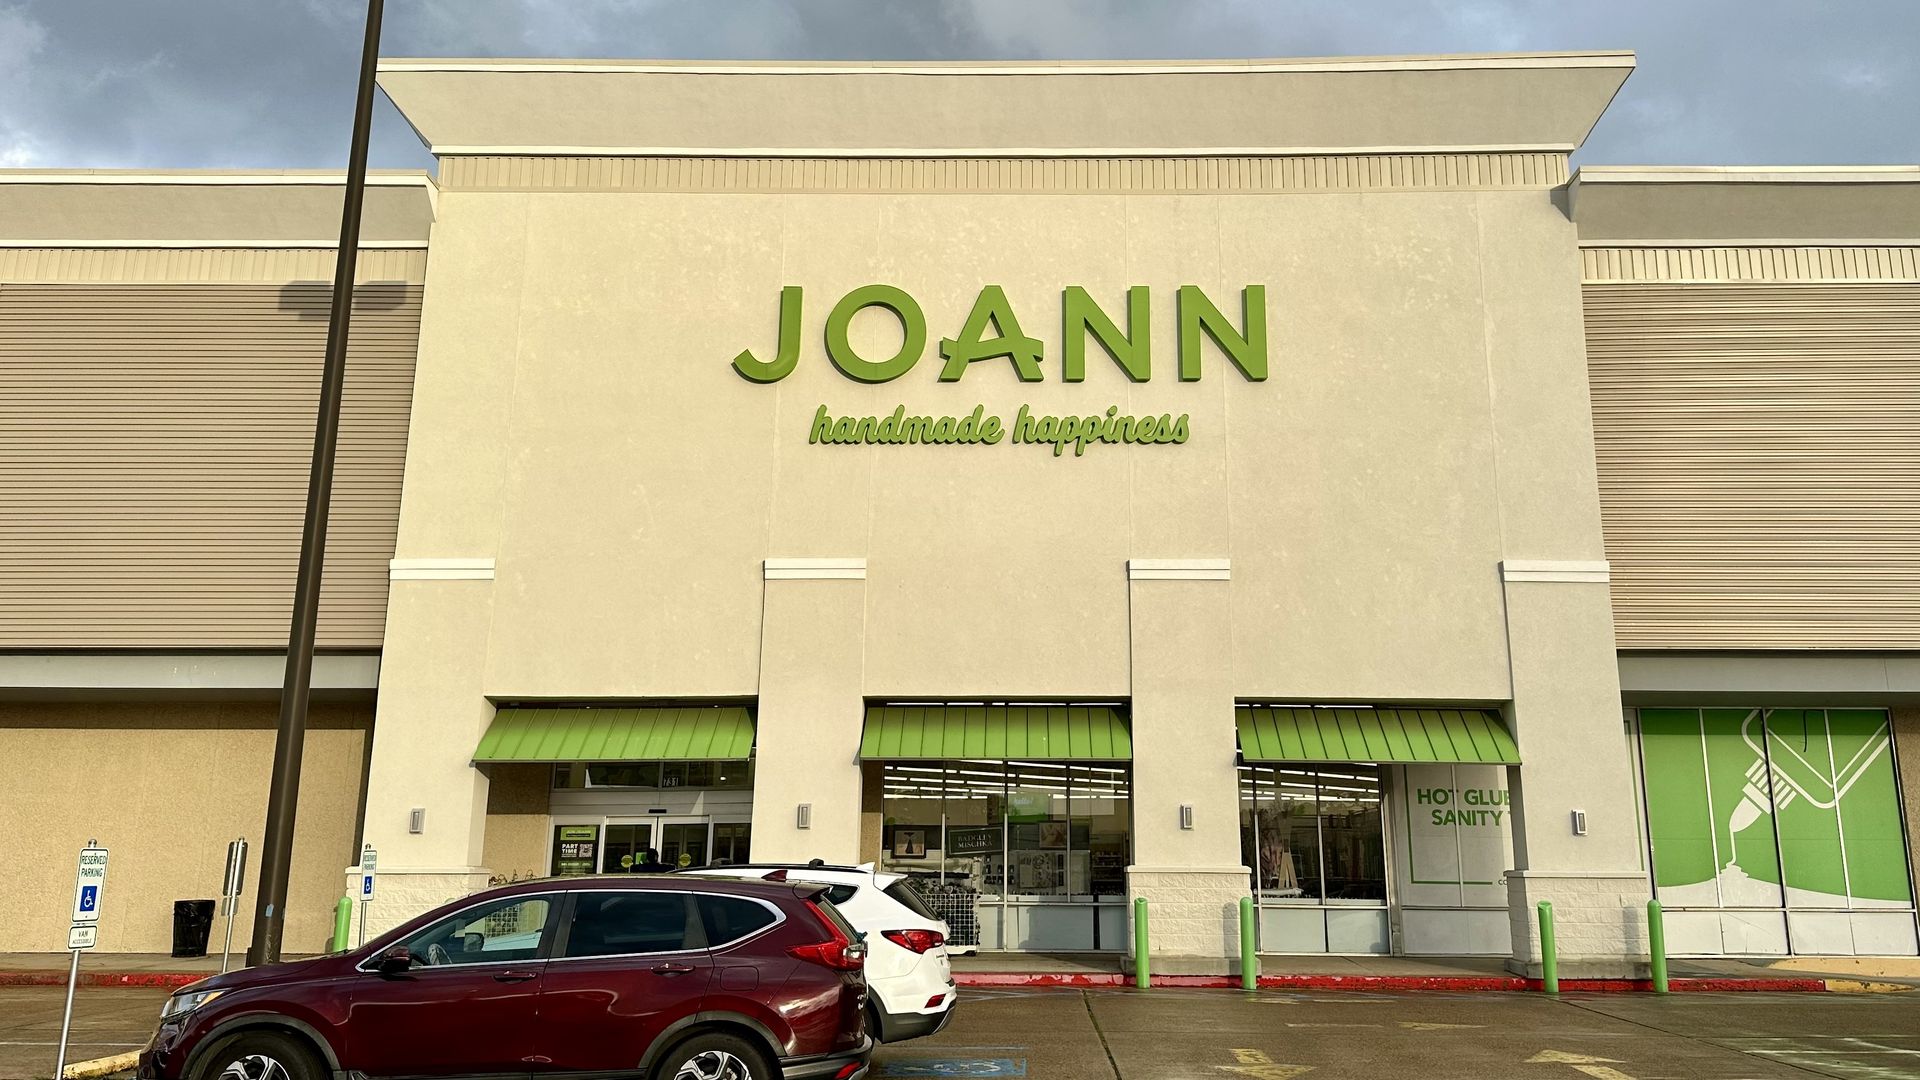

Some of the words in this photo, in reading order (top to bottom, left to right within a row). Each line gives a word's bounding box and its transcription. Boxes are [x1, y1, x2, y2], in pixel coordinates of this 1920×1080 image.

[731, 284, 1269, 384] JOANN
[808, 403, 1005, 445] handmade
[1012, 403, 1191, 458] happiness
[1431, 809, 1503, 826] SANITY
[81, 855, 107, 865] RESERVED
[81, 867, 103, 877] PARKING
